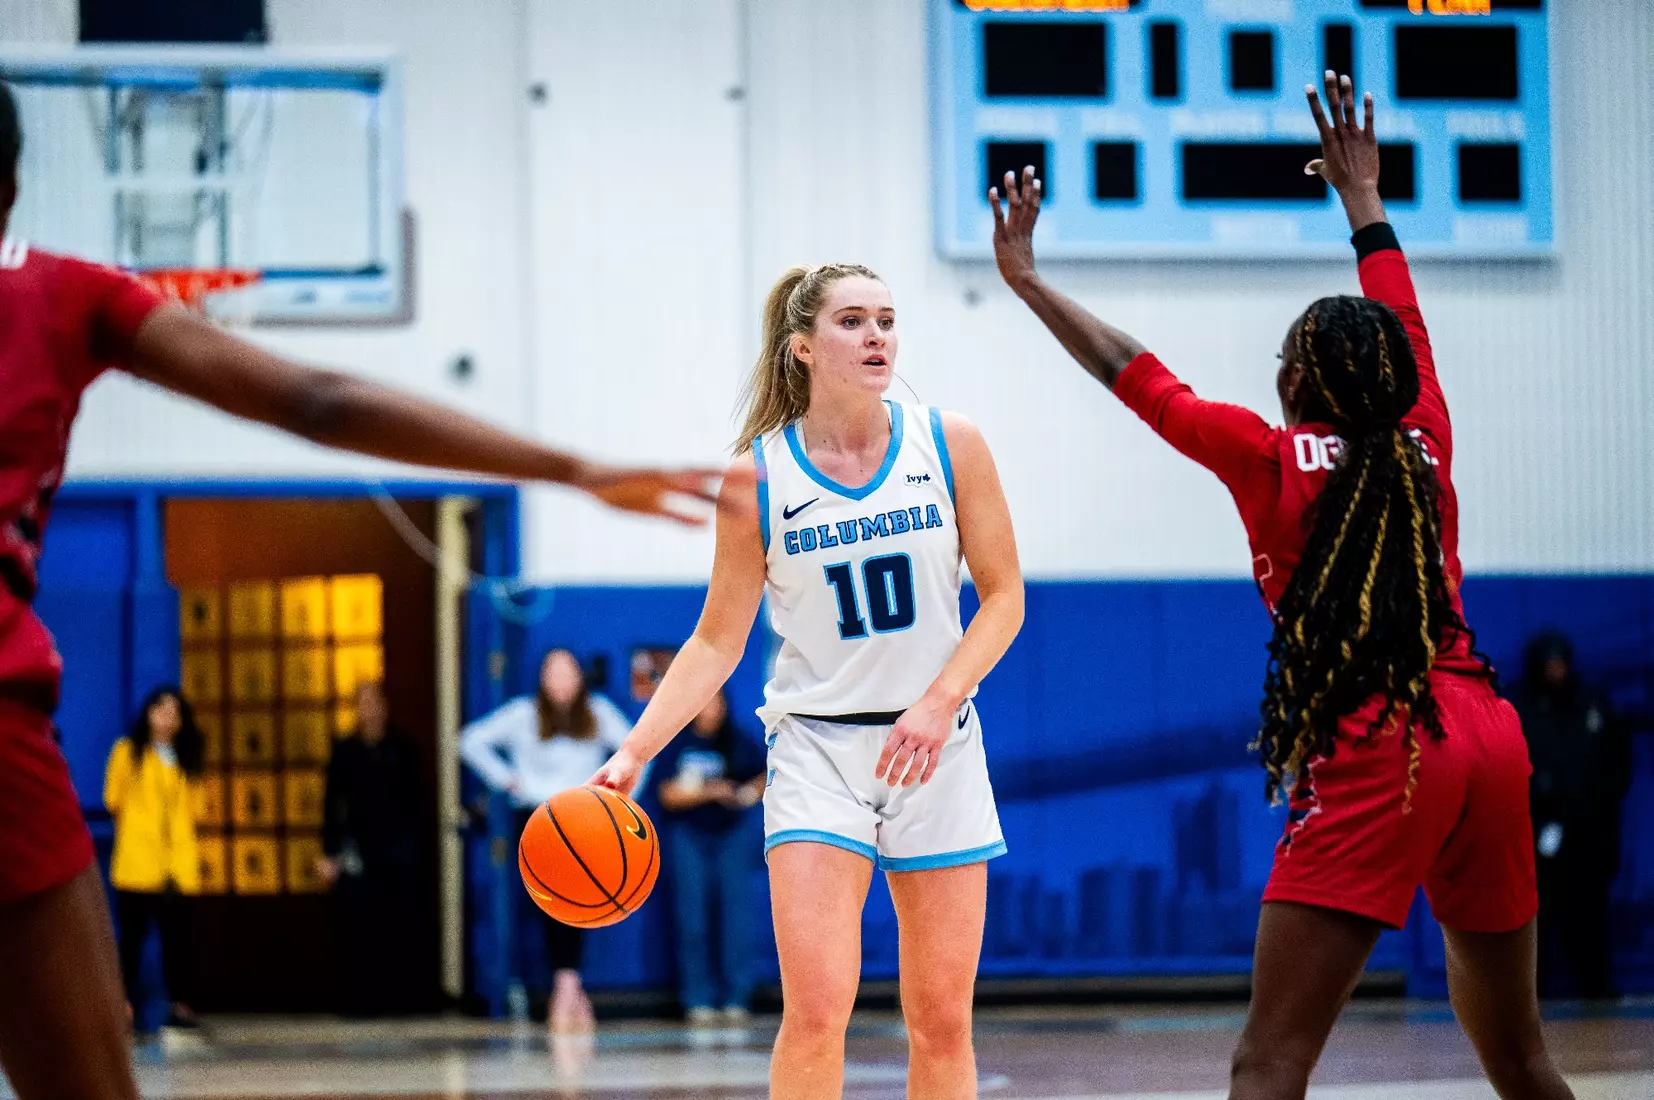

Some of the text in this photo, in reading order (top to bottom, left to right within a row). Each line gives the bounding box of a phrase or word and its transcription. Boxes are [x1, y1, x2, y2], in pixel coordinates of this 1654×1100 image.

[905, 474, 922, 485] Ivy
[784, 504, 943, 555] COLUMBIA
[823, 552, 917, 640] 10
